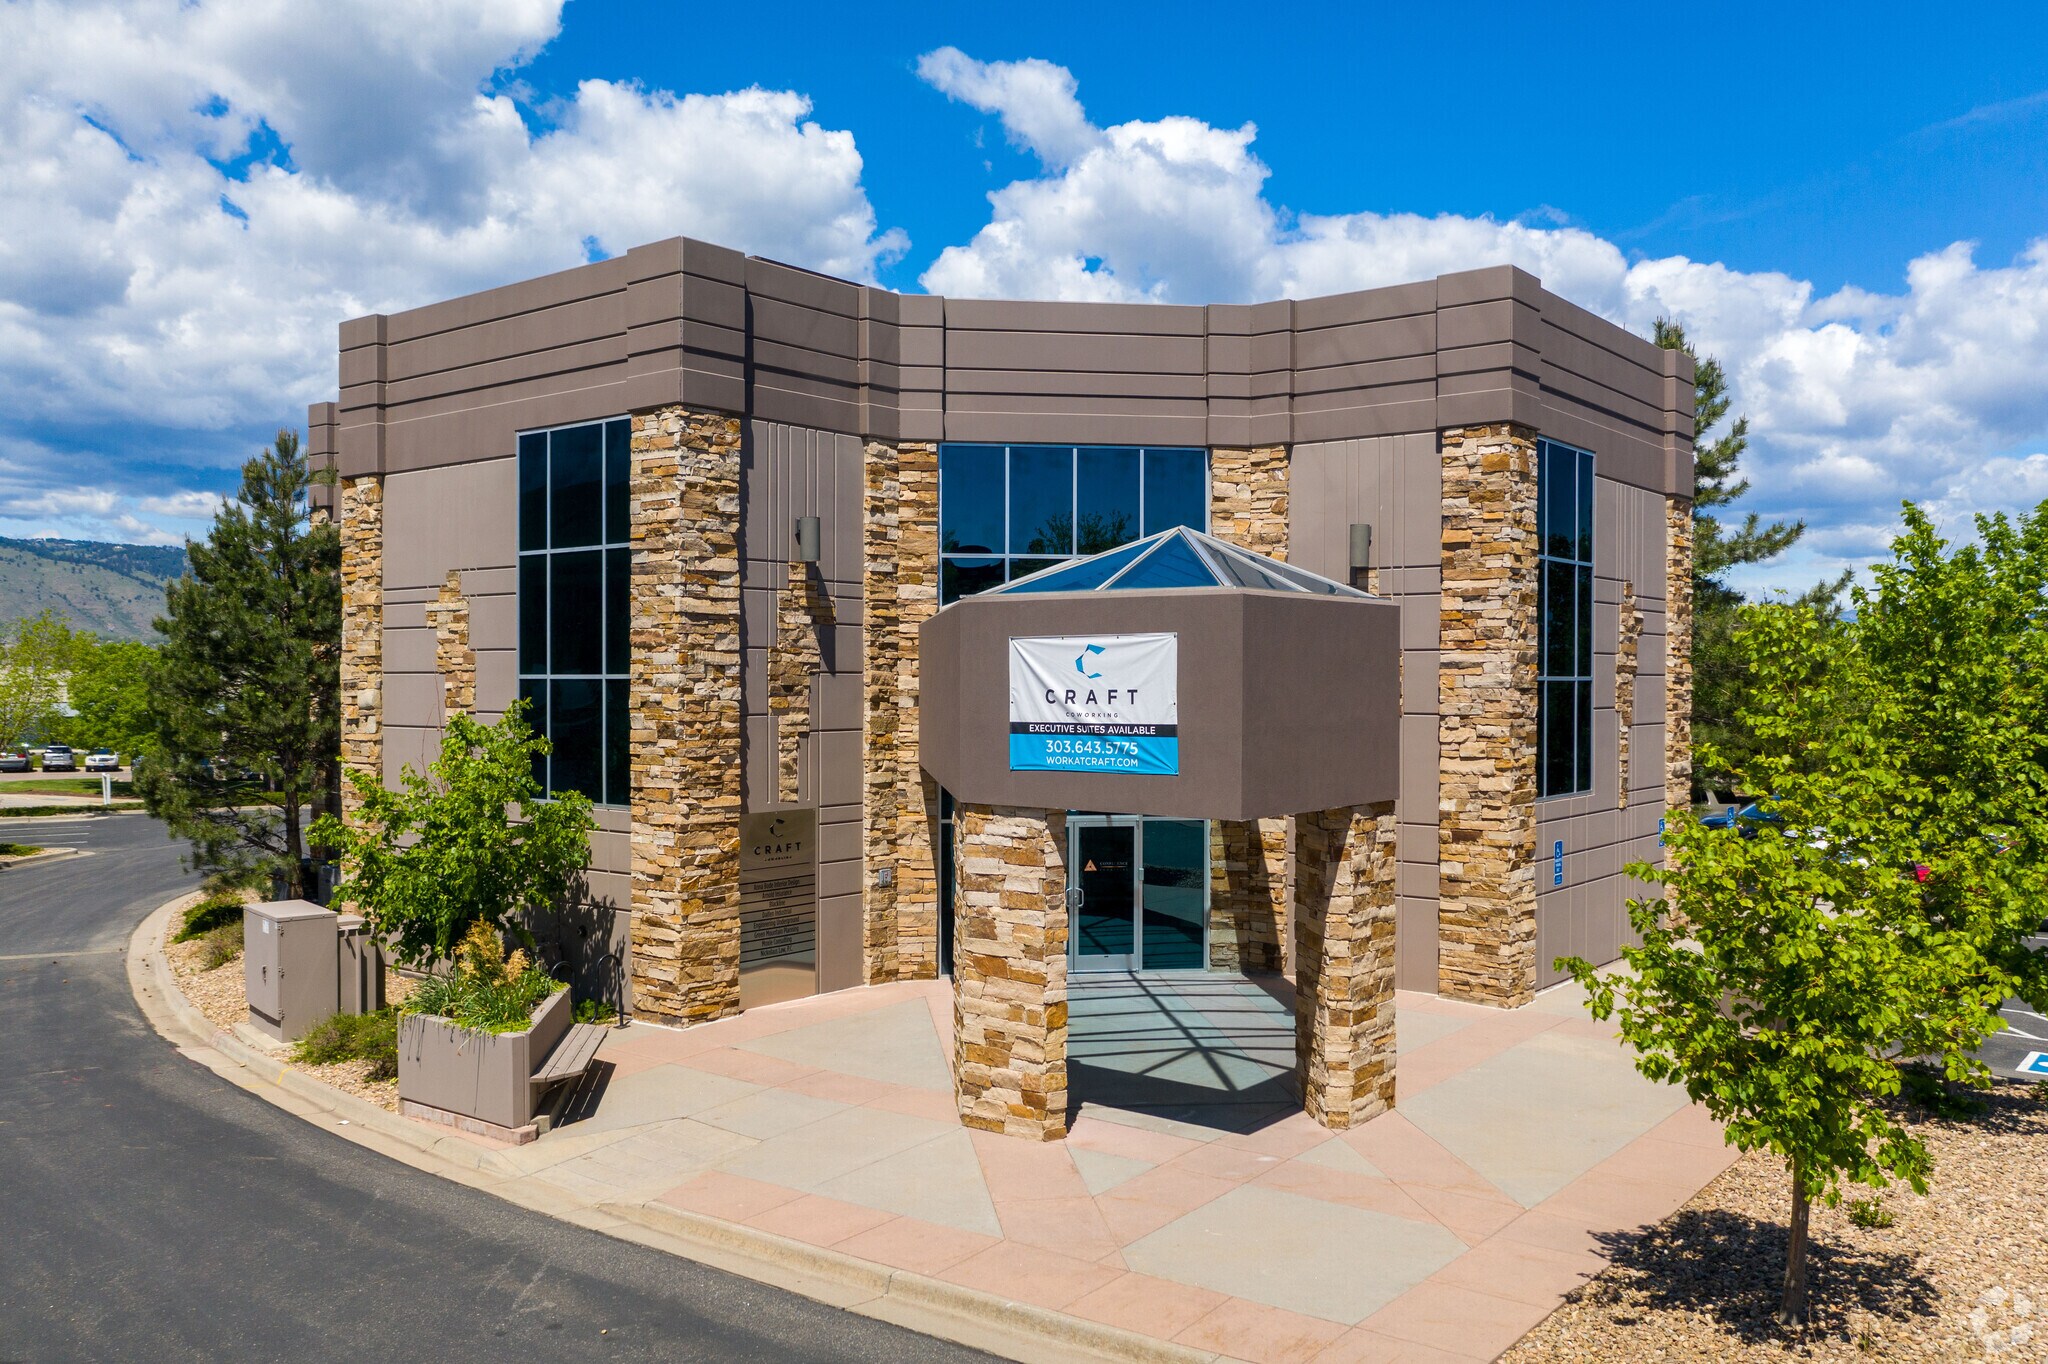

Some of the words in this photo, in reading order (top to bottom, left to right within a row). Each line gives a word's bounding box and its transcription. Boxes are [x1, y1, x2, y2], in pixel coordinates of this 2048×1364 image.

[1045, 689, 1138, 705] CRAFT
[1029, 724, 1075, 733] EXECUTIVE
[1076, 725, 1106, 734] SUITES
[1107, 725, 1156, 735] AVAILABLE
[1045, 739, 1139, 755] 303.643.5775
[1045, 756, 1139, 767] WORKATCRAFT.COM
[754, 842, 801, 855] CRAFT
